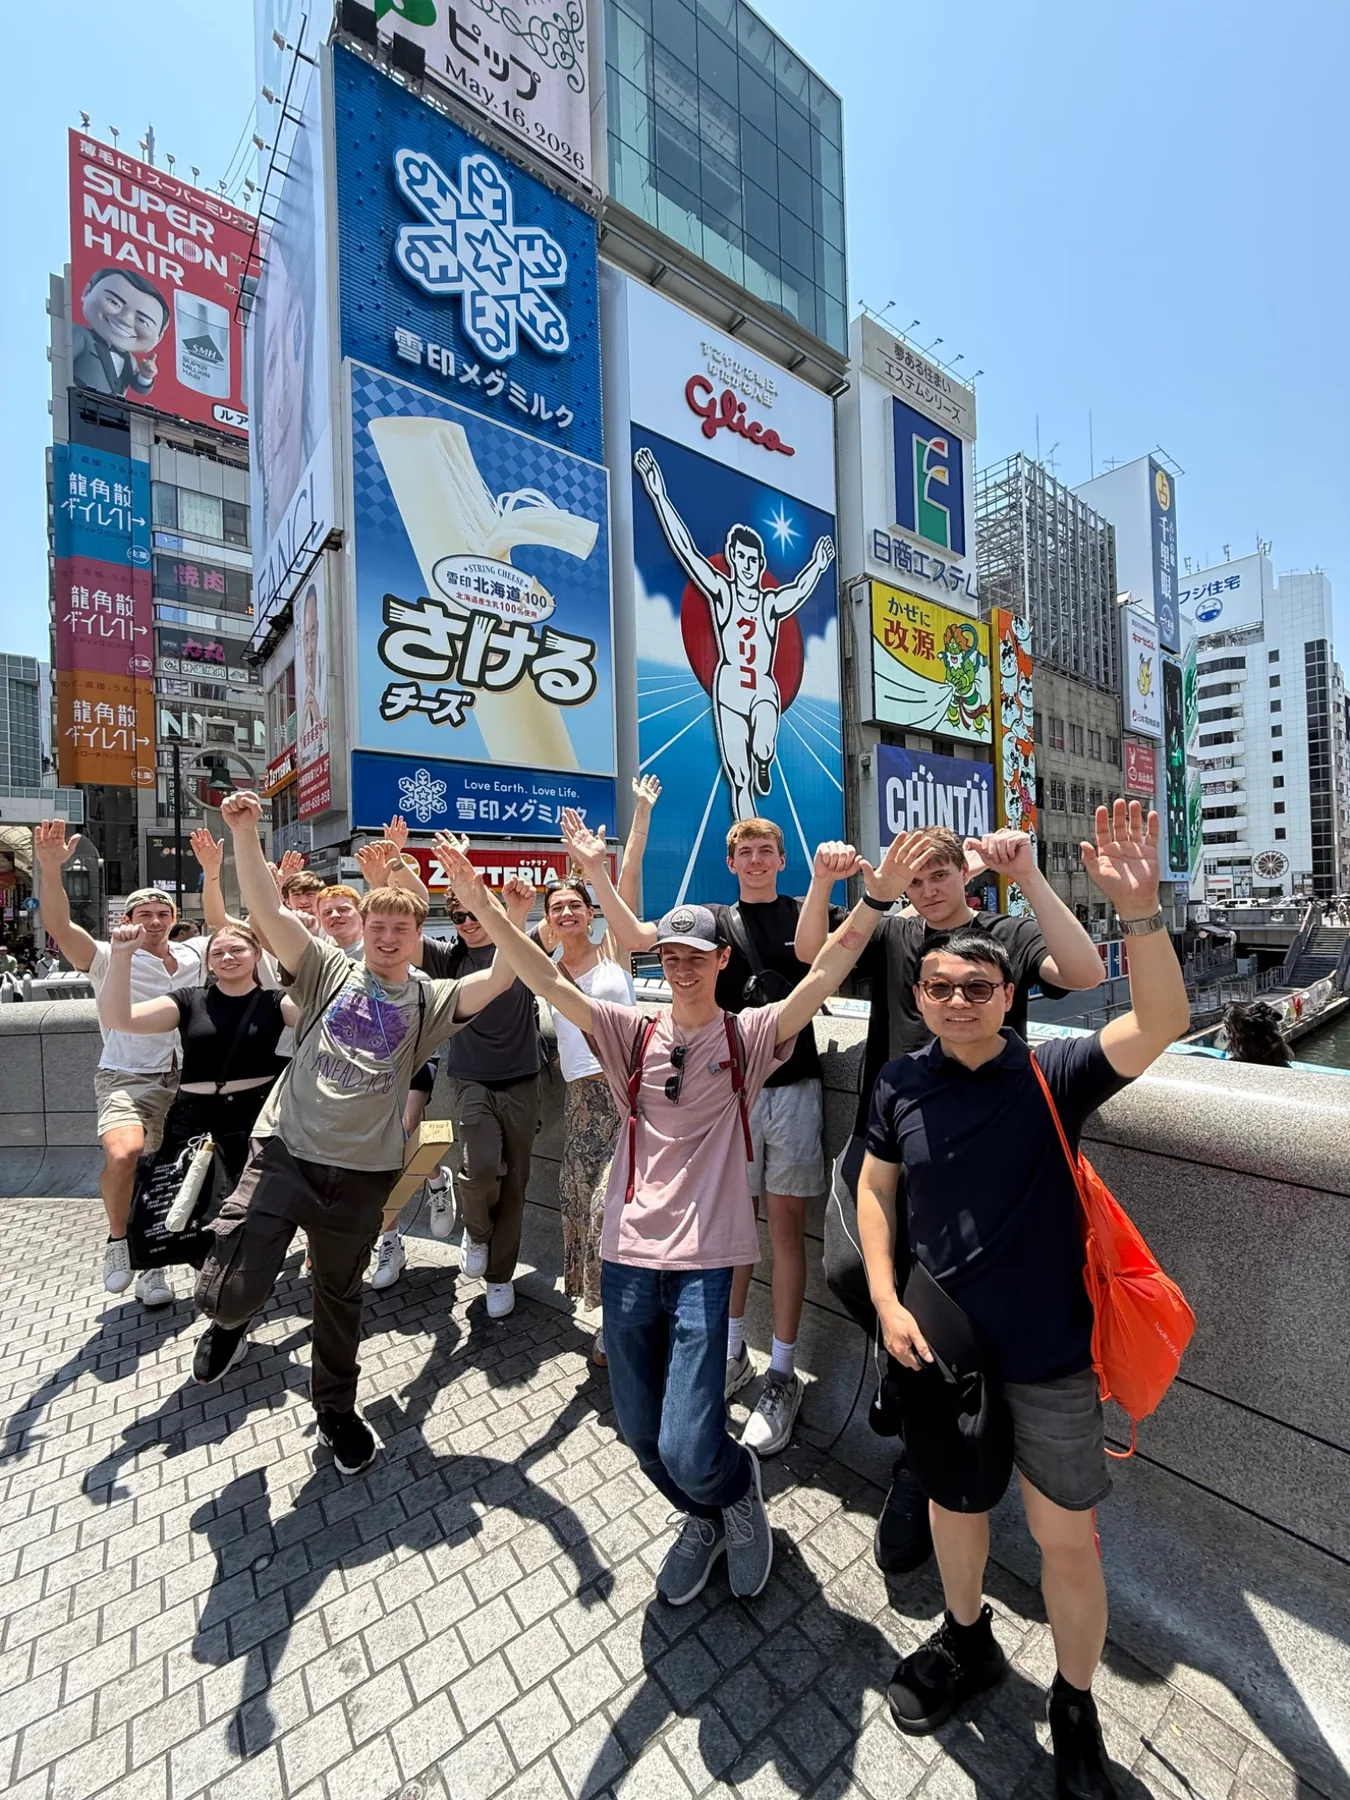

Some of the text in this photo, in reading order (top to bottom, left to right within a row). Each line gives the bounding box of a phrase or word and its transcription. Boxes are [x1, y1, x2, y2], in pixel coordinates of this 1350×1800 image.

[449, 5, 541, 100] ピップ
[83, 164, 215, 244] SUPER
[83, 193, 228, 278] MILLION
[84, 224, 185, 287] HAIR
[192, 344, 217, 360] SMH
[894, 342, 951, 393] 夢ある住まい
[395, 326, 574, 429] 雪印メグミルク
[884, 360, 961, 424] エステムシリーズ
[685, 374, 796, 457] Glico
[69, 472, 133, 508] 龍角散
[61, 497, 146, 532] ダイレクト
[258, 471, 326, 636] FANCL
[468, 564, 525, 587] STRING CHEESE
[71, 585, 136, 617] 龍角散
[1178, 574, 1241, 605] フジ住宅
[63, 611, 148, 641] ダイレクト
[887, 596, 931, 628] かぜに
[381, 596, 597, 704] さける
[736, 616, 757, 691] グリコ
[882, 617, 937, 661] 改源
[73, 699, 138, 728] 龍角散
[384, 684, 472, 725] チーズ
[65, 725, 150, 752] ダイレクト
[464, 778, 580, 799] Love Earth. Love Life.
[310, 1051, 364, 1089] KNEAD
[365, 1071, 397, 1095] YOU
